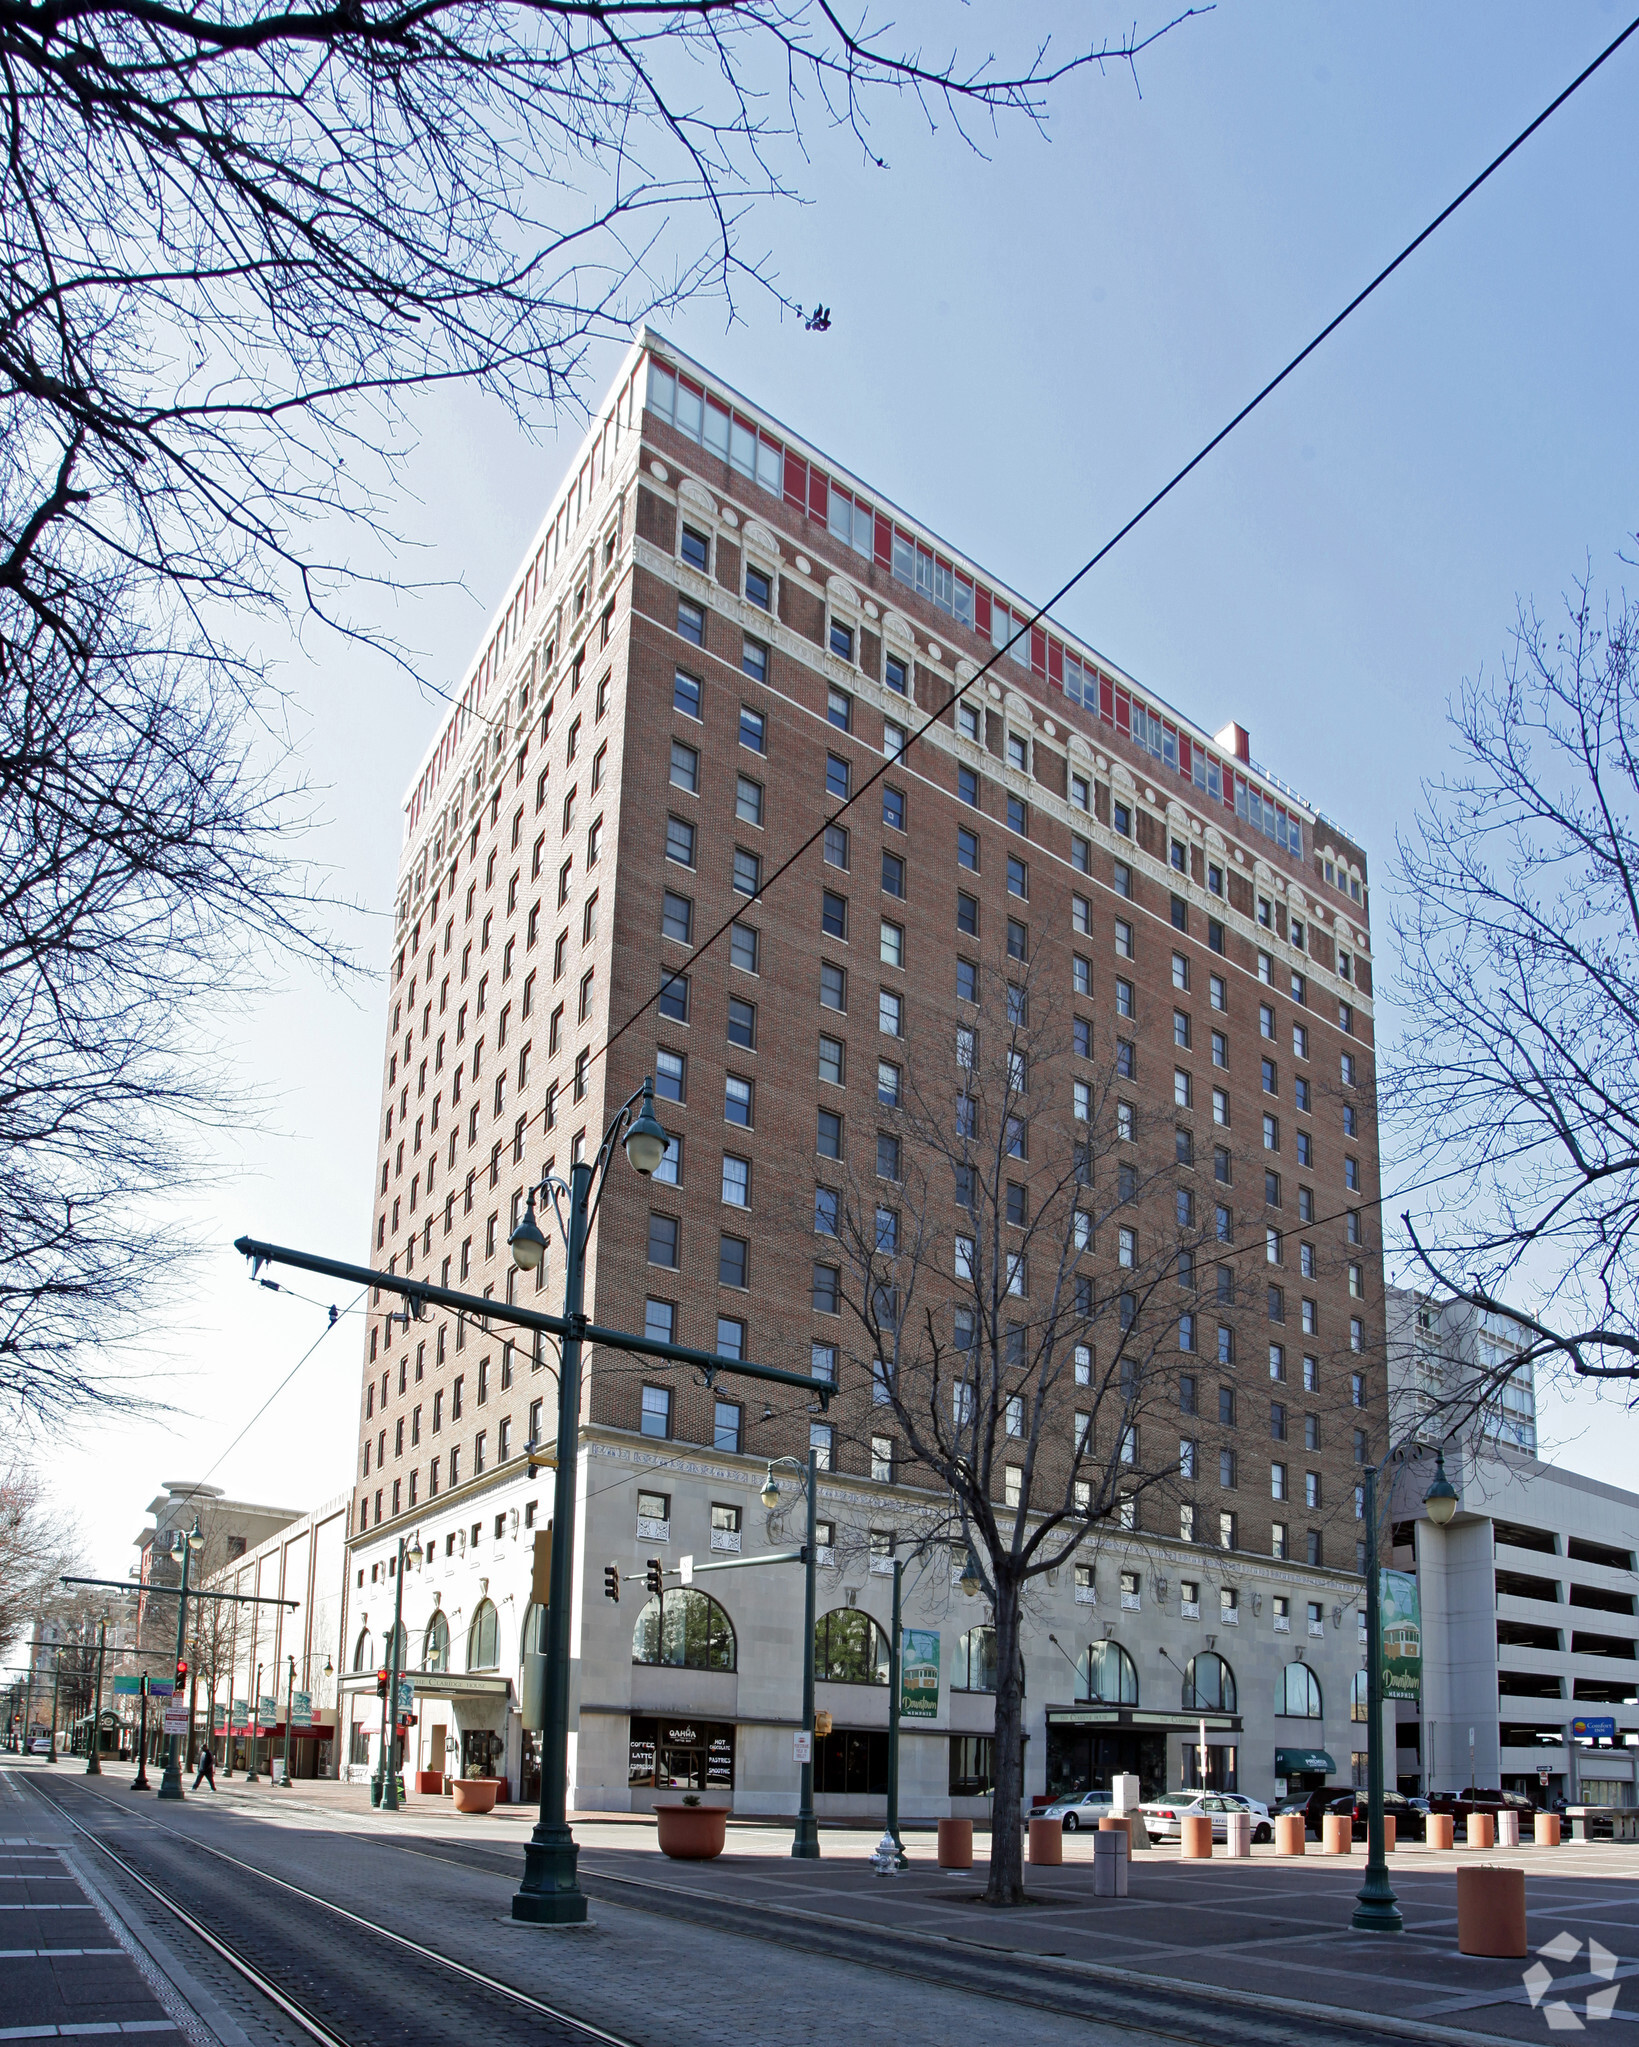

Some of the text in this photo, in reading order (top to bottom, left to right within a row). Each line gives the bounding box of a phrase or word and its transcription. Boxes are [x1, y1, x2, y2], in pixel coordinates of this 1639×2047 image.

[1382, 1668, 1420, 1691] Downtown
[1388, 1691, 1415, 1699] MEMPHIS
[902, 1695, 937, 1711] Downtown
[708, 1756, 731, 1764] PASTRIES
[708, 1767, 731, 1775] SMOOTHIE
